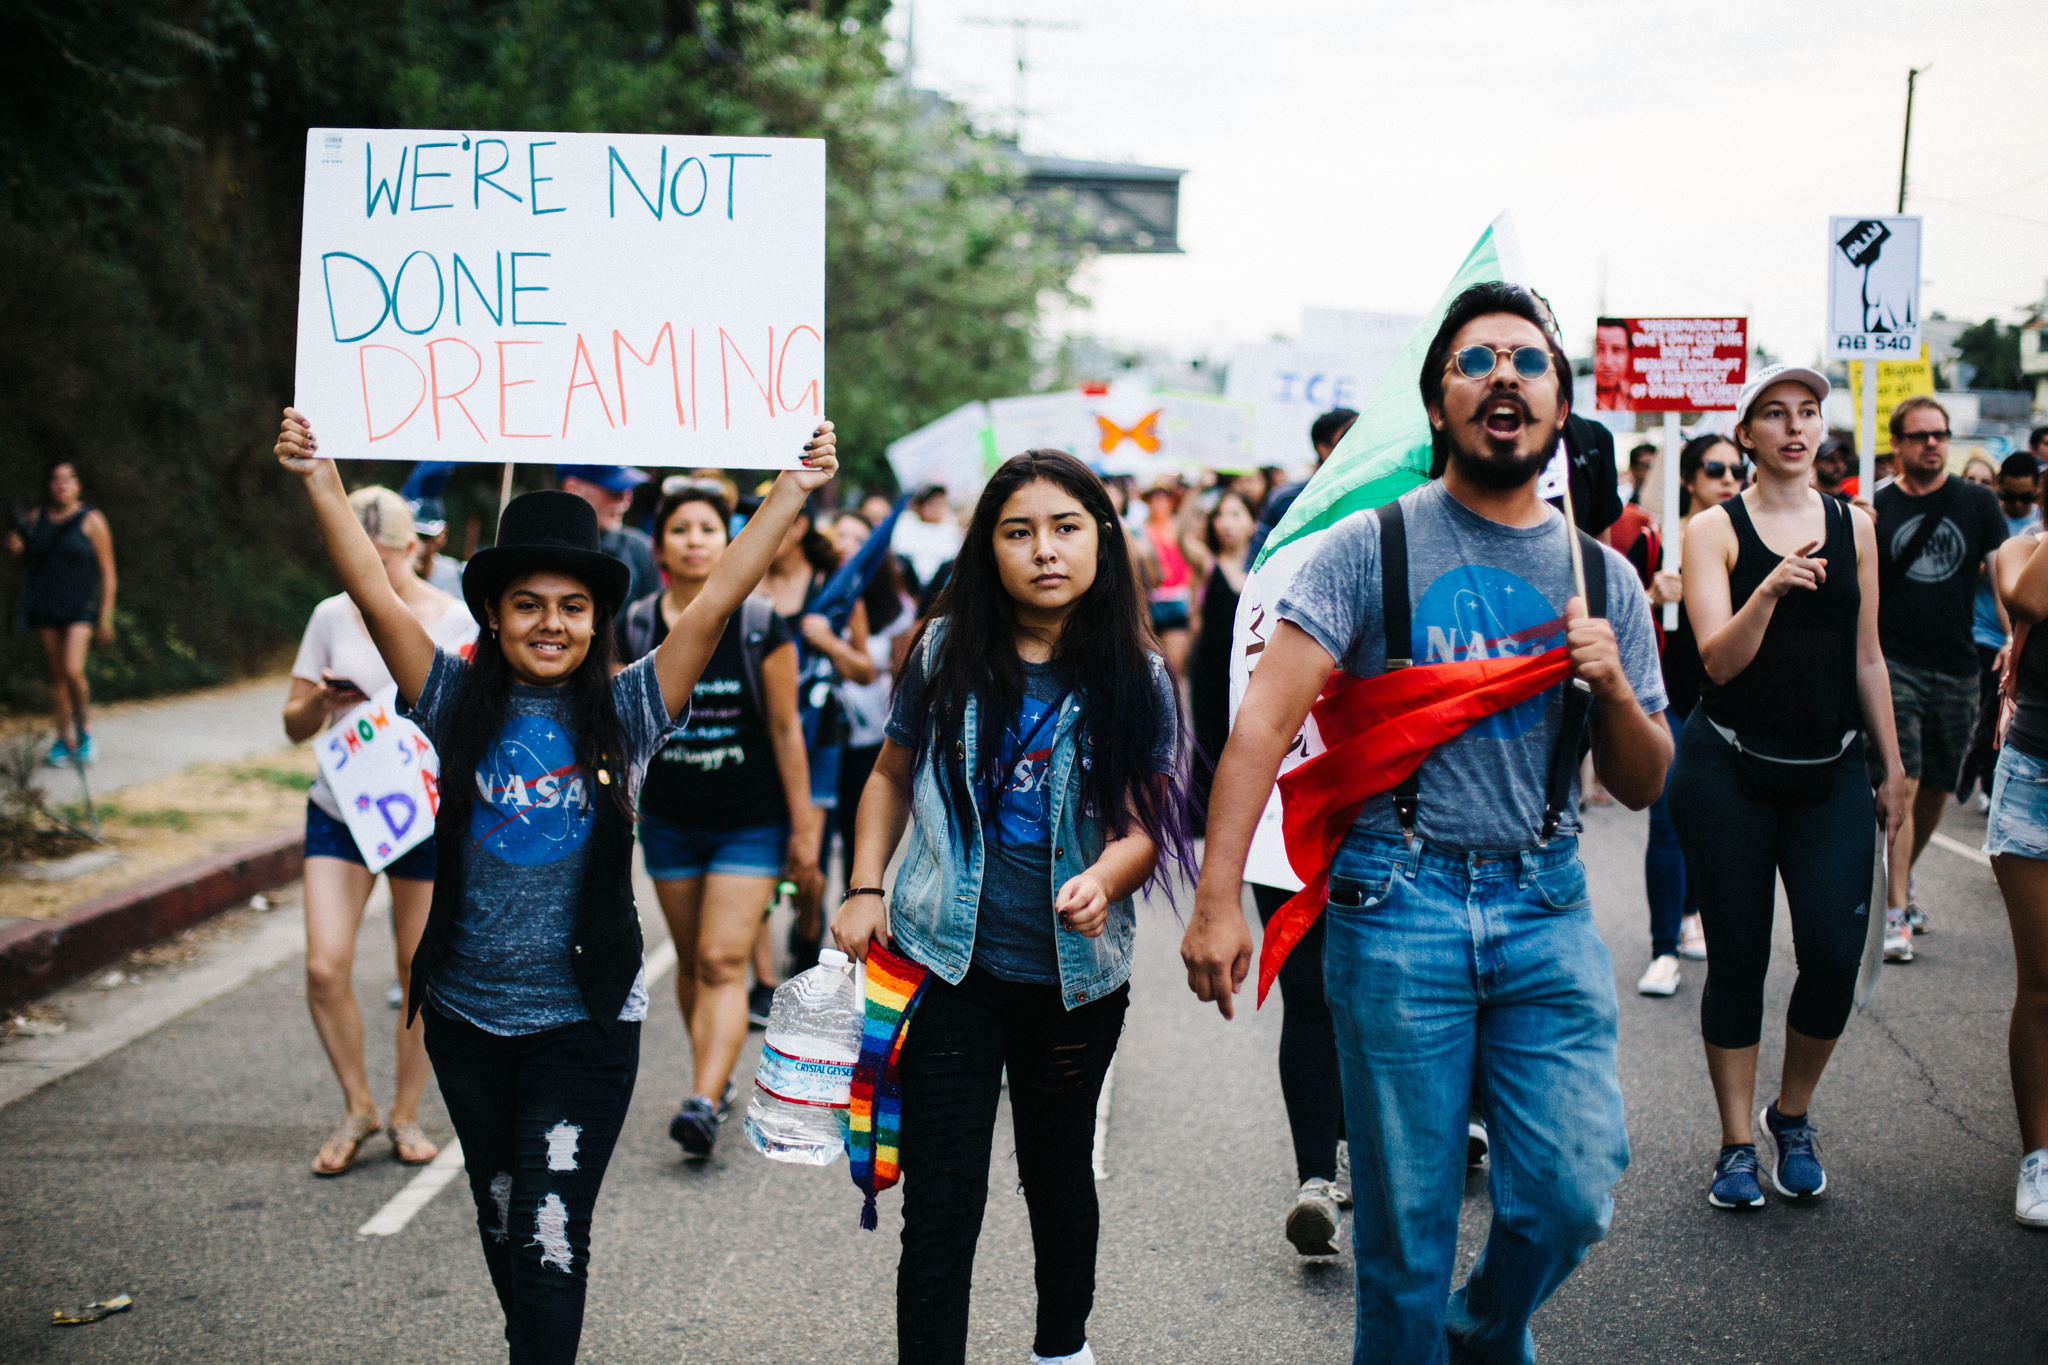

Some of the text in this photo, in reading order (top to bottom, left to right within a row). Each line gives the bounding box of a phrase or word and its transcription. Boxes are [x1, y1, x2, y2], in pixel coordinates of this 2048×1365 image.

[366, 134, 772, 221] WE'RE NOT
[322, 250, 567, 343] DONE
[1837, 335, 1911, 350] AB 540
[360, 321, 822, 443] DREAMING
[329, 704, 389, 770] SHOW
[475, 770, 594, 811] NASA
[795, 1062, 826, 1074] CRYSTAL
